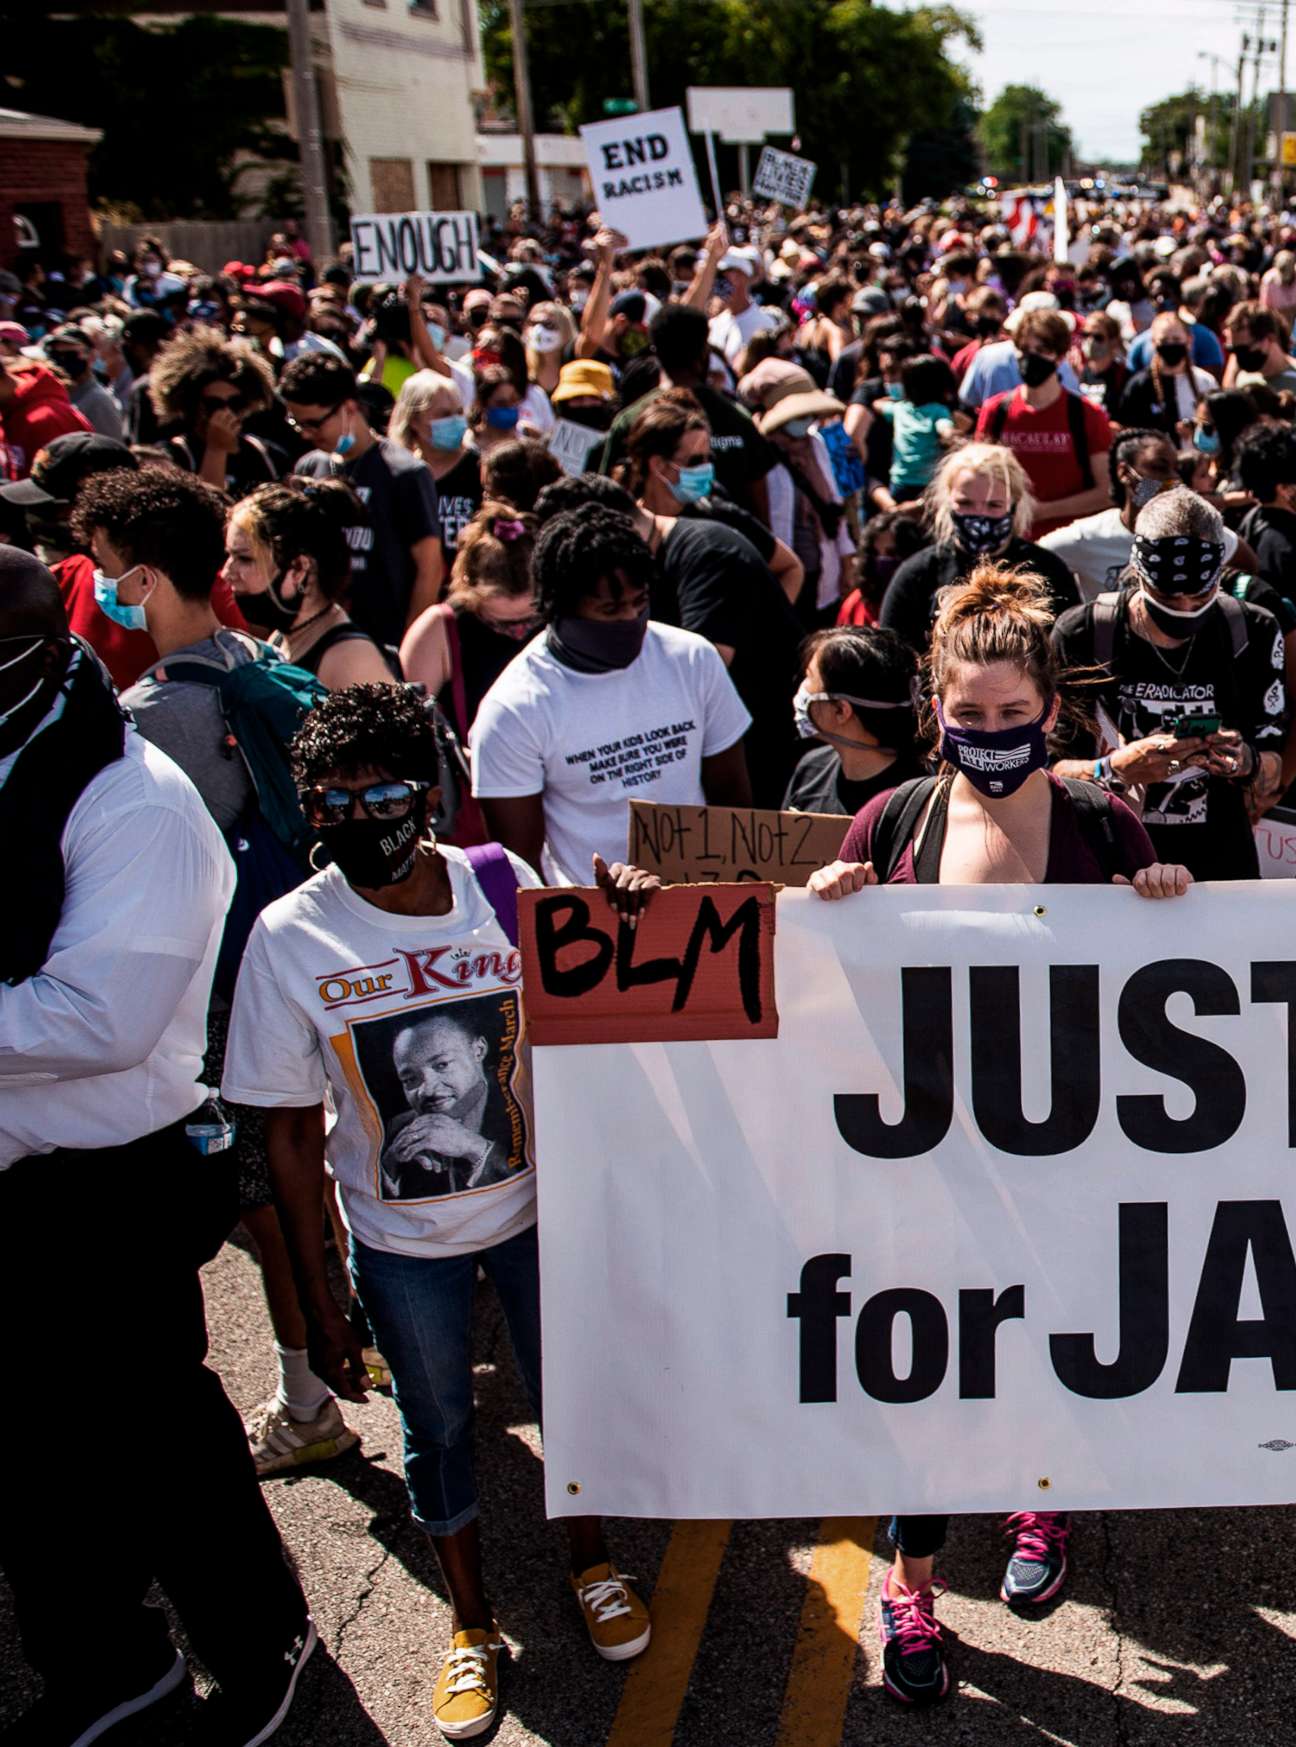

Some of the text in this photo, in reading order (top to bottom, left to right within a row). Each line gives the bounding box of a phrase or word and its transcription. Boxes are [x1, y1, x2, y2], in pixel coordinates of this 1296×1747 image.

[602, 133, 669, 170] END
[602, 167, 684, 199] RACISM
[352, 217, 476, 276] ENOUGH
[1135, 682, 1215, 700] ERADICATOR
[565, 719, 696, 765] WHEN YOUR KIDS LOOK BACK
[589, 734, 688, 772] MAKE SURE YOU WERE
[957, 744, 995, 762] PROTECT
[590, 748, 687, 785] ON THE RIGHT SIDE OF
[622, 769, 662, 788] HISTORY
[984, 757, 1030, 772] WORKERS
[379, 816, 416, 857] BLACK
[633, 807, 691, 866] Not
[731, 811, 789, 867] Not
[535, 893, 762, 1024] BLM
[318, 973, 393, 1003] Our
[499, 999, 516, 1051] March
[787, 1253, 1025, 1404] for
